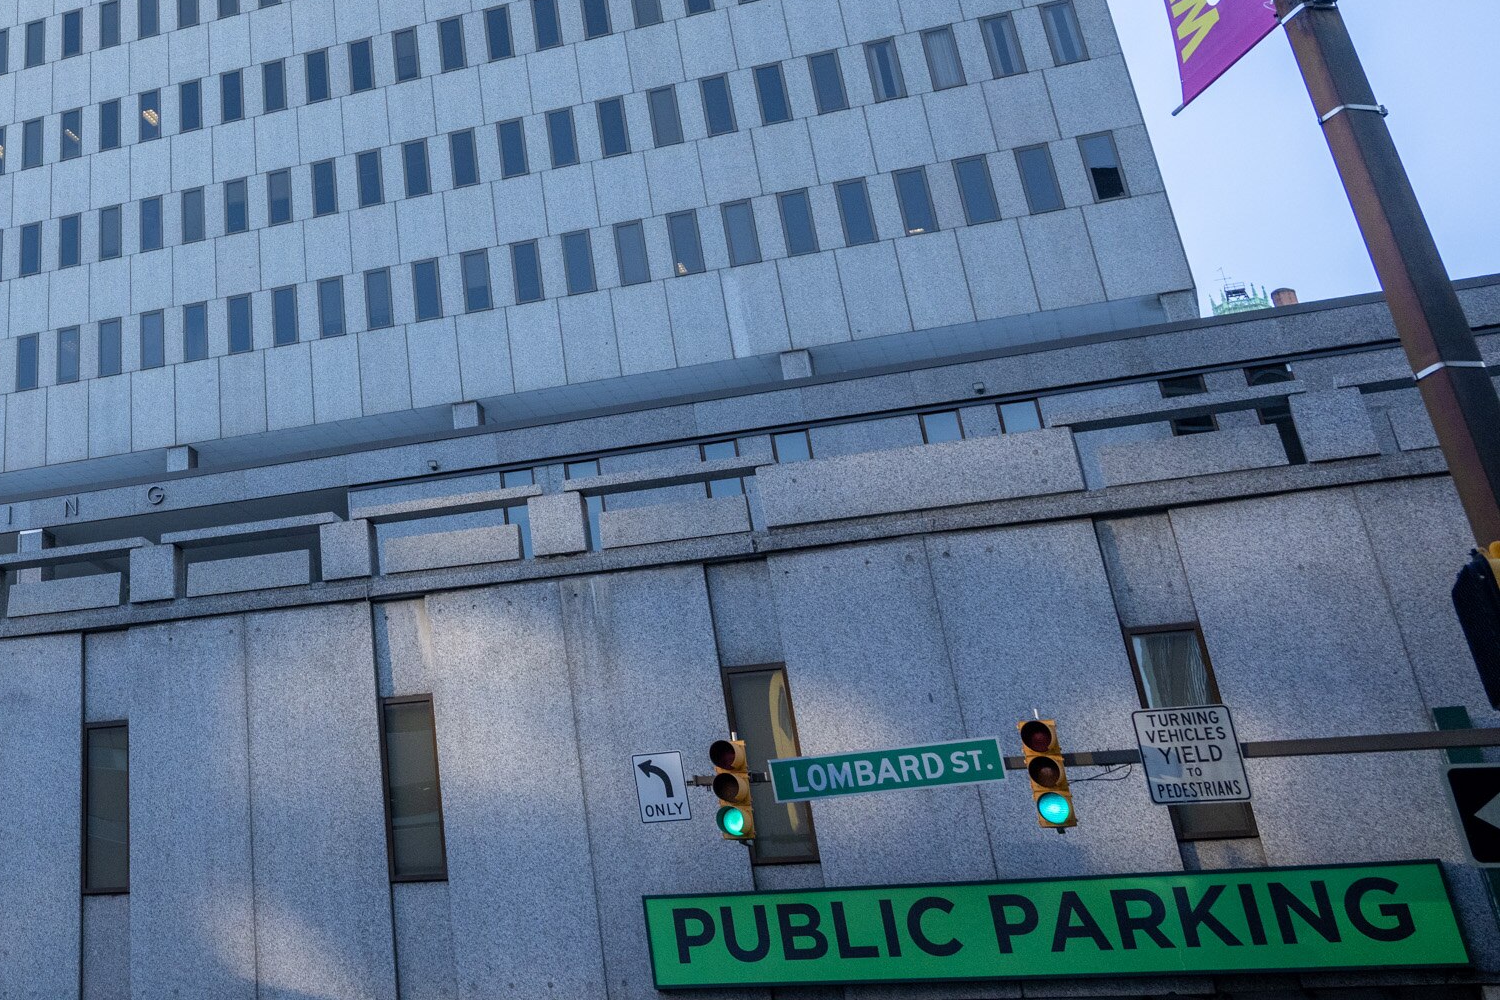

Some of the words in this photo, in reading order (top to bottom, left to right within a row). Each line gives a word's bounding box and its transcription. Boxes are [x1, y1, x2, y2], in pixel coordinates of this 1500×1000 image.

[1146, 710, 1219, 727] TURNING
[1145, 726, 1226, 743] VEHICLES
[1158, 744, 1223, 765] YIELD
[789, 752, 945, 793] LOMBARD
[950, 749, 994, 773] ST.
[1186, 766, 1203, 777] TO
[1157, 780, 1242, 799] PEDESTRIANS
[645, 801, 684, 818] ONLY
[672, 896, 965, 964] PUBLIC
[987, 876, 1417, 954] PARKING
